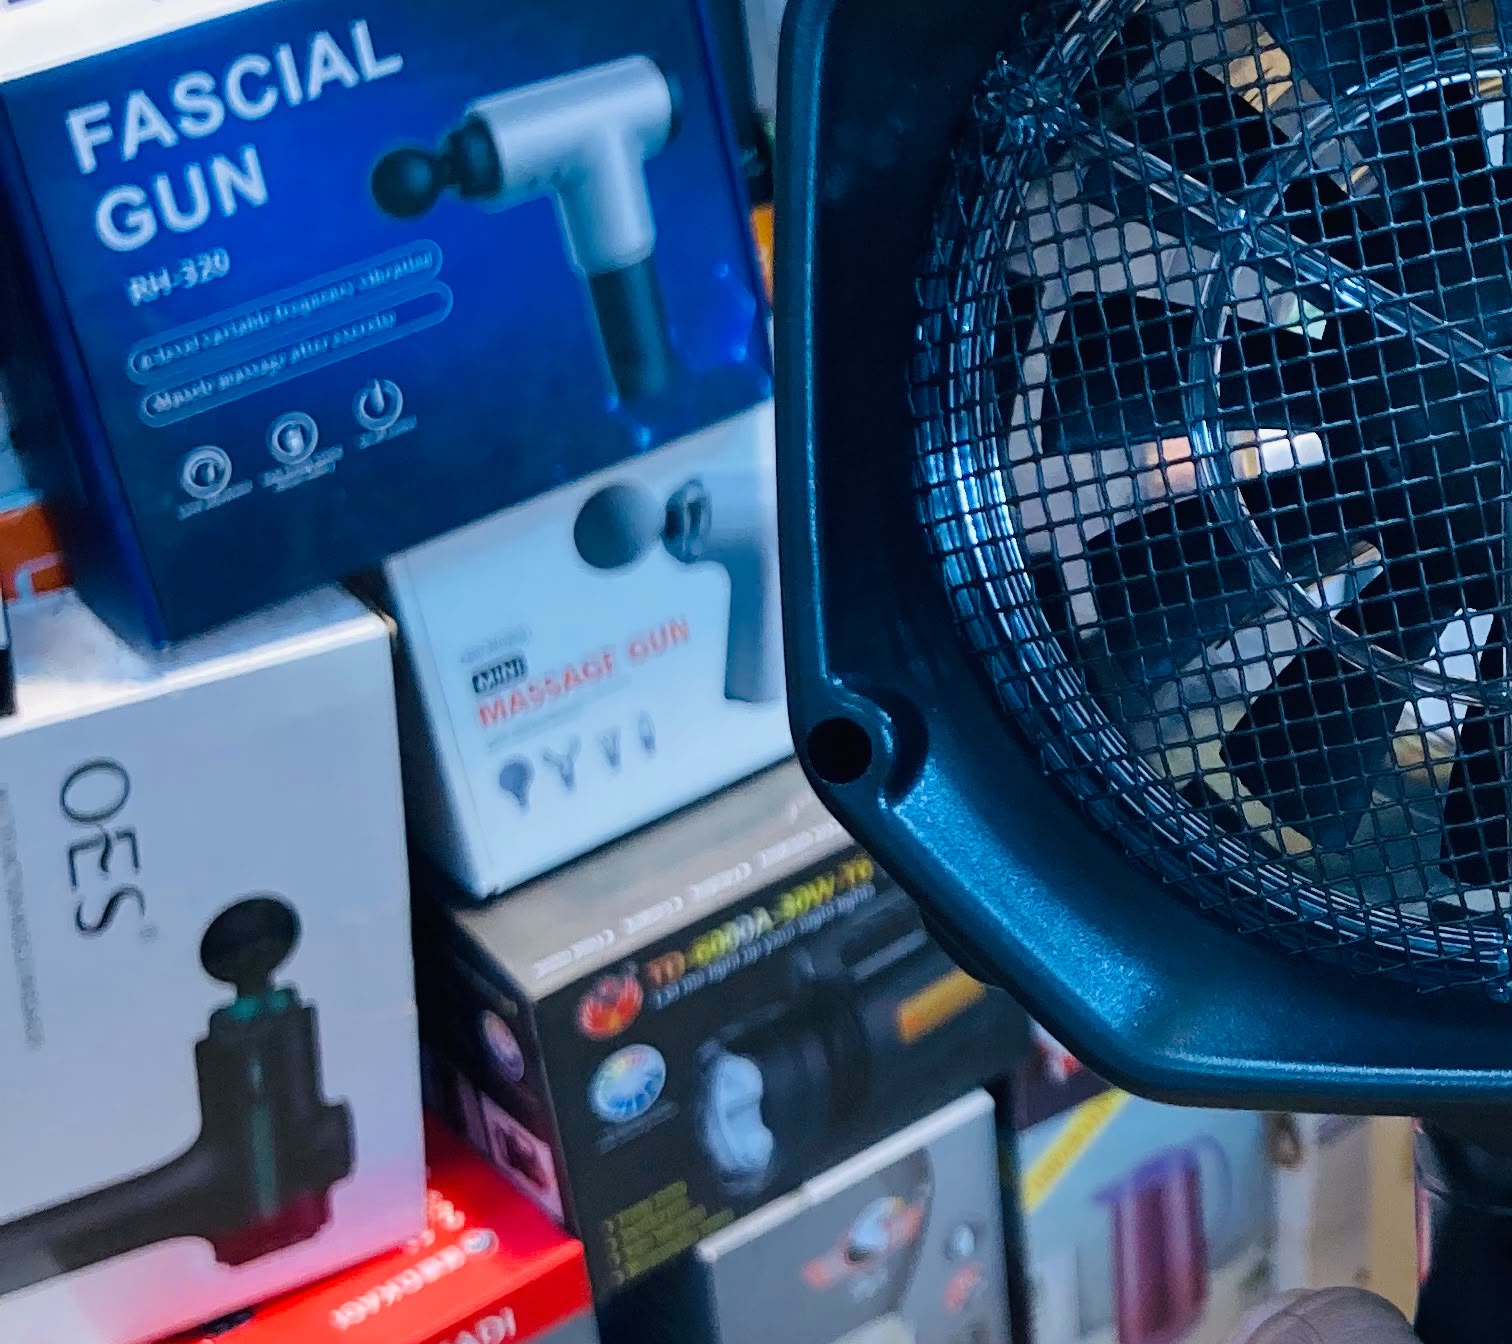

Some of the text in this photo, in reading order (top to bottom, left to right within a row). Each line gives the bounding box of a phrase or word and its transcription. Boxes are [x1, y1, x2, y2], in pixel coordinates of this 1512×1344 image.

[66, 19, 404, 175] FASCIAL
[97, 146, 270, 252] GUN
[478, 650, 618, 730] MASSAGE
[625, 616, 691, 665] GUN
